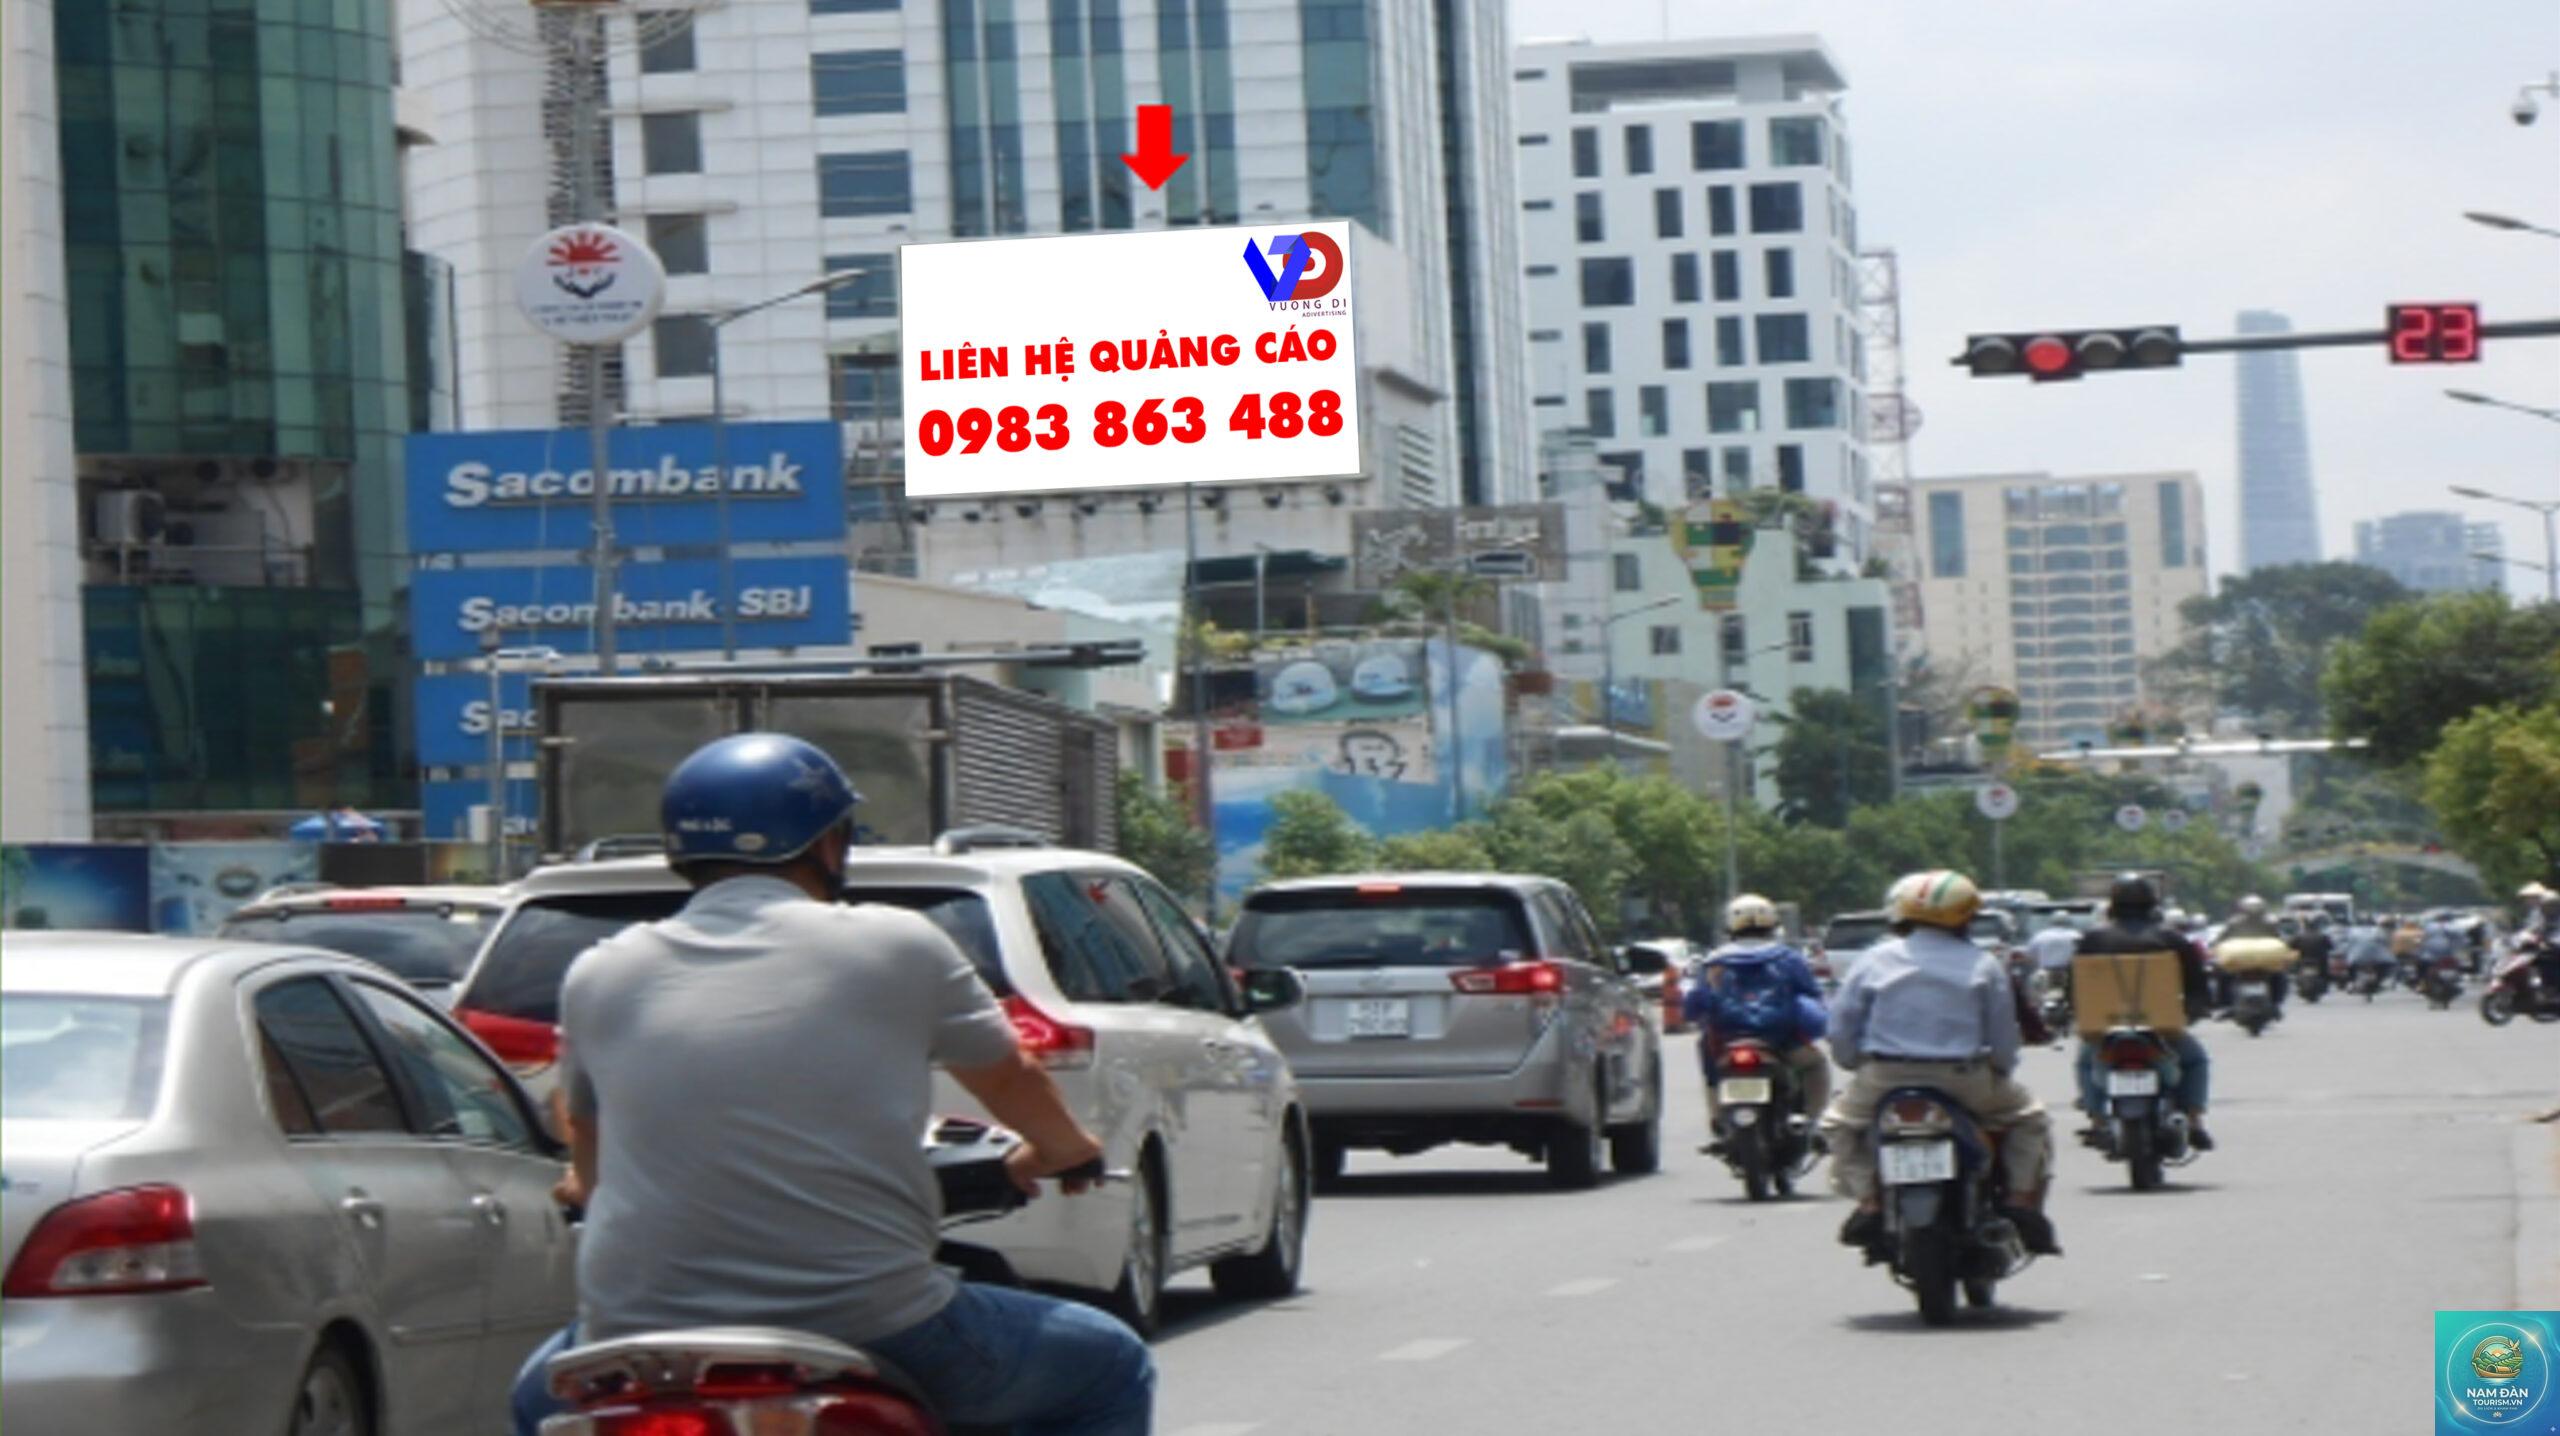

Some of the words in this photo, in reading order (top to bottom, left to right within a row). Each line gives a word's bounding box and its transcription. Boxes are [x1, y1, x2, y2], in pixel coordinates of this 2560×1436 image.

[1269, 300, 1322, 311] VUONG
[1332, 298, 1347, 308] DI
[920, 340, 1008, 382] LIÊN
[1025, 336, 1075, 383] HỆ
[1089, 329, 1241, 373] QUẢNG
[1255, 324, 1338, 364] CÁO
[2395, 308, 2474, 358] 23
[918, 403, 1070, 457] 0983
[1093, 397, 1207, 448] 863
[1229, 389, 1344, 440] 488
[444, 452, 803, 507] Sacombank
[737, 585, 812, 616] SBJ
